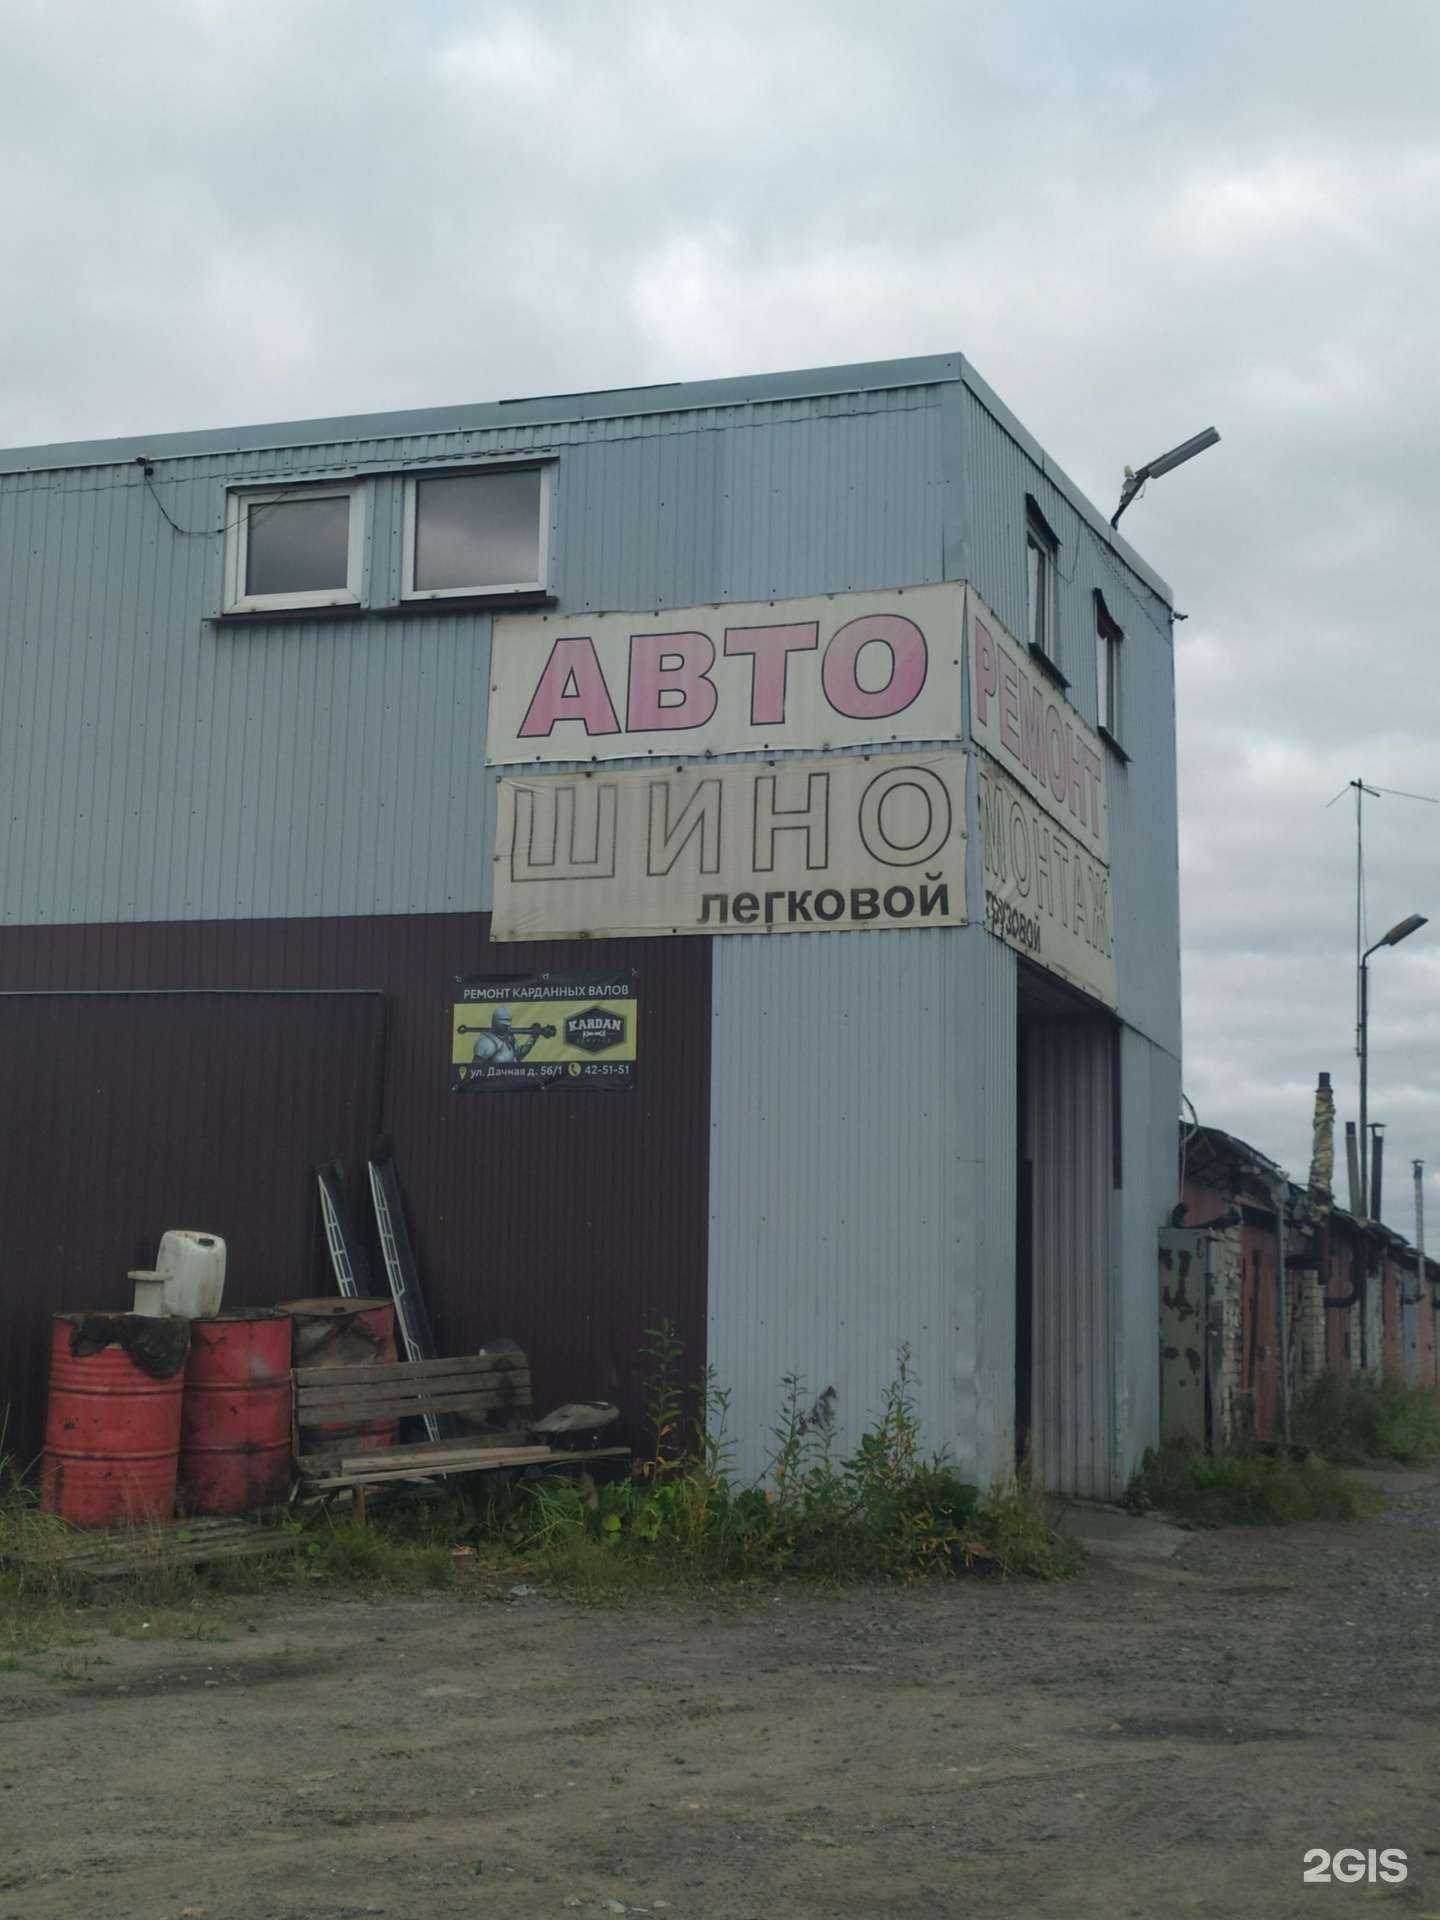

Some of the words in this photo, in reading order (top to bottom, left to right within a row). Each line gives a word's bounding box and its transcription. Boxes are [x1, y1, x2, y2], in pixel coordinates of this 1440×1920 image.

[517, 613, 928, 738] АВТО
[974, 616, 1101, 839] РЕМОНТ
[510, 766, 952, 882] ШИНО
[979, 771, 1112, 960] МОНТАЖ
[697, 871, 950, 925] легковой
[463, 988, 510, 1000] РЕМОНТ
[513, 986, 586, 999] КАРДАННЫХ
[588, 985, 630, 996] ВАЛОВ
[568, 1018, 622, 1032] KARDAN
[470, 1068, 485, 1080] ул.
[540, 1065, 563, 1077] 56/1
[584, 1065, 630, 1076] 42-51-51
